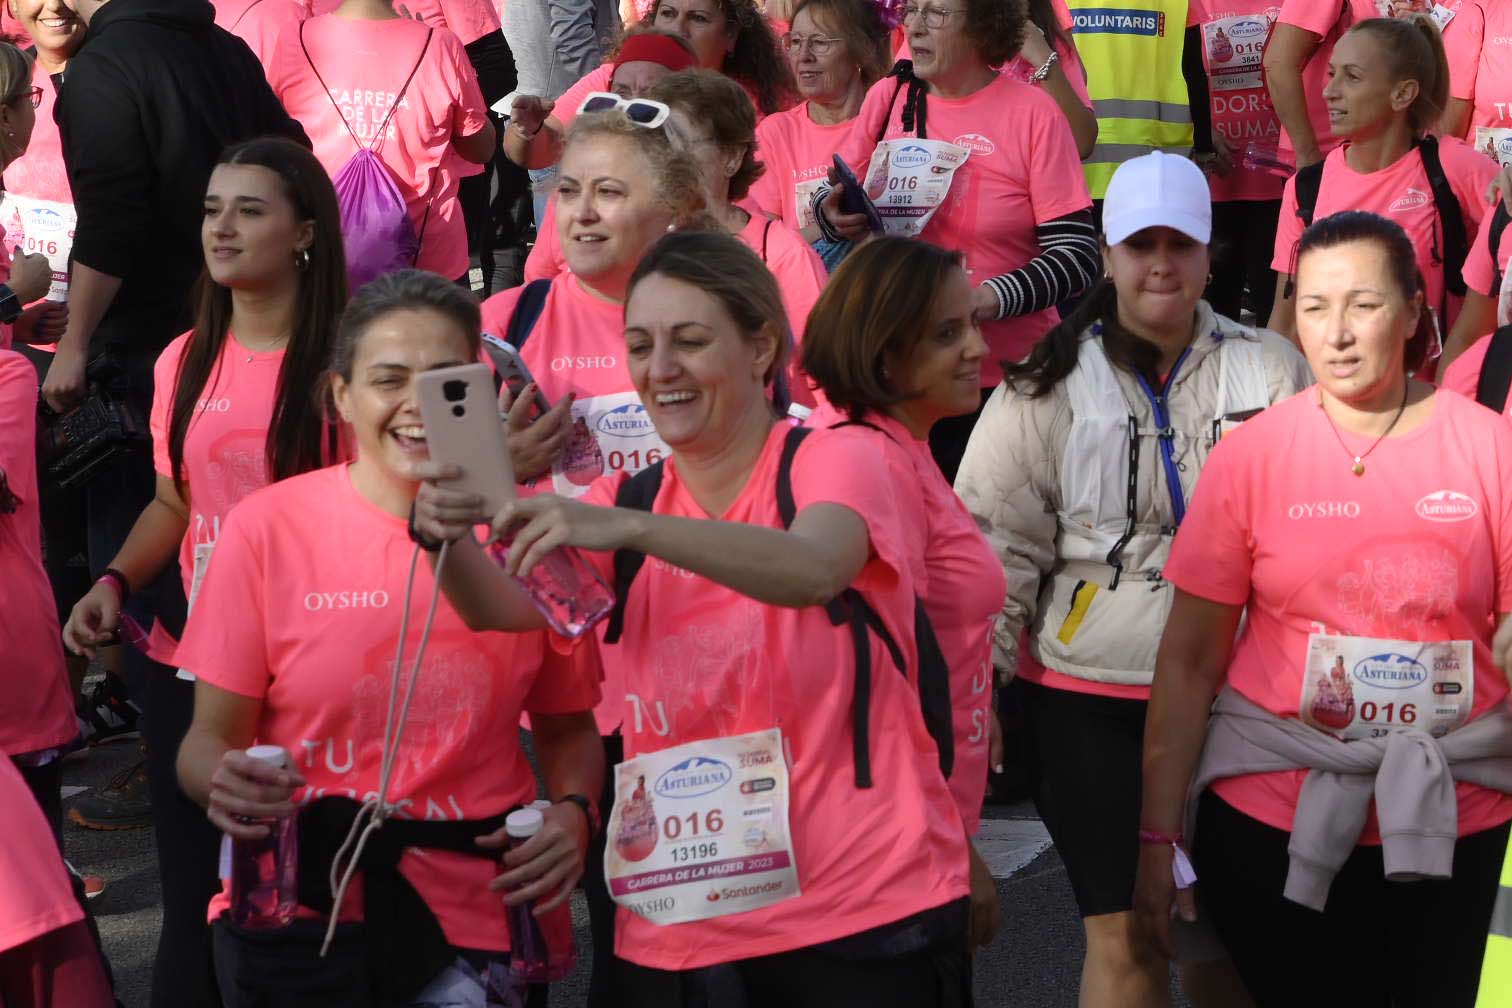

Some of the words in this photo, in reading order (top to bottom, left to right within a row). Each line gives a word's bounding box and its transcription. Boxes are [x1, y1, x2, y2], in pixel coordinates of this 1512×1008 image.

[1072, 15, 1156, 30] VOLUNTARIS
[1235, 42, 1264, 55] 016
[1241, 55, 1260, 64] 3841
[342, 105, 365, 122] DE
[1215, 119, 1280, 139] SUMA
[888, 175, 919, 191] 016
[27, 237, 58, 255] 016
[550, 354, 617, 372] OYSHO
[602, 416, 650, 431] ASTURIA
[607, 448, 664, 471] 016
[1288, 500, 1361, 521] OYSHO
[1421, 503, 1473, 515] ASTURIANA
[303, 589, 389, 612] OYSHO
[1360, 664, 1423, 682] ASTURIANA
[624, 694, 671, 736] TU
[1359, 701, 1418, 725] 016
[300, 738, 354, 775] TU
[659, 771, 727, 793] ASTURIANA
[663, 808, 725, 840] 016
[671, 842, 719, 863] 13196
[627, 873, 674, 890] CARRERA
[675, 870, 689, 881] DE
[691, 867, 706, 879] LA
[706, 862, 745, 877] MUJER
[721, 880, 784, 902] Santander
